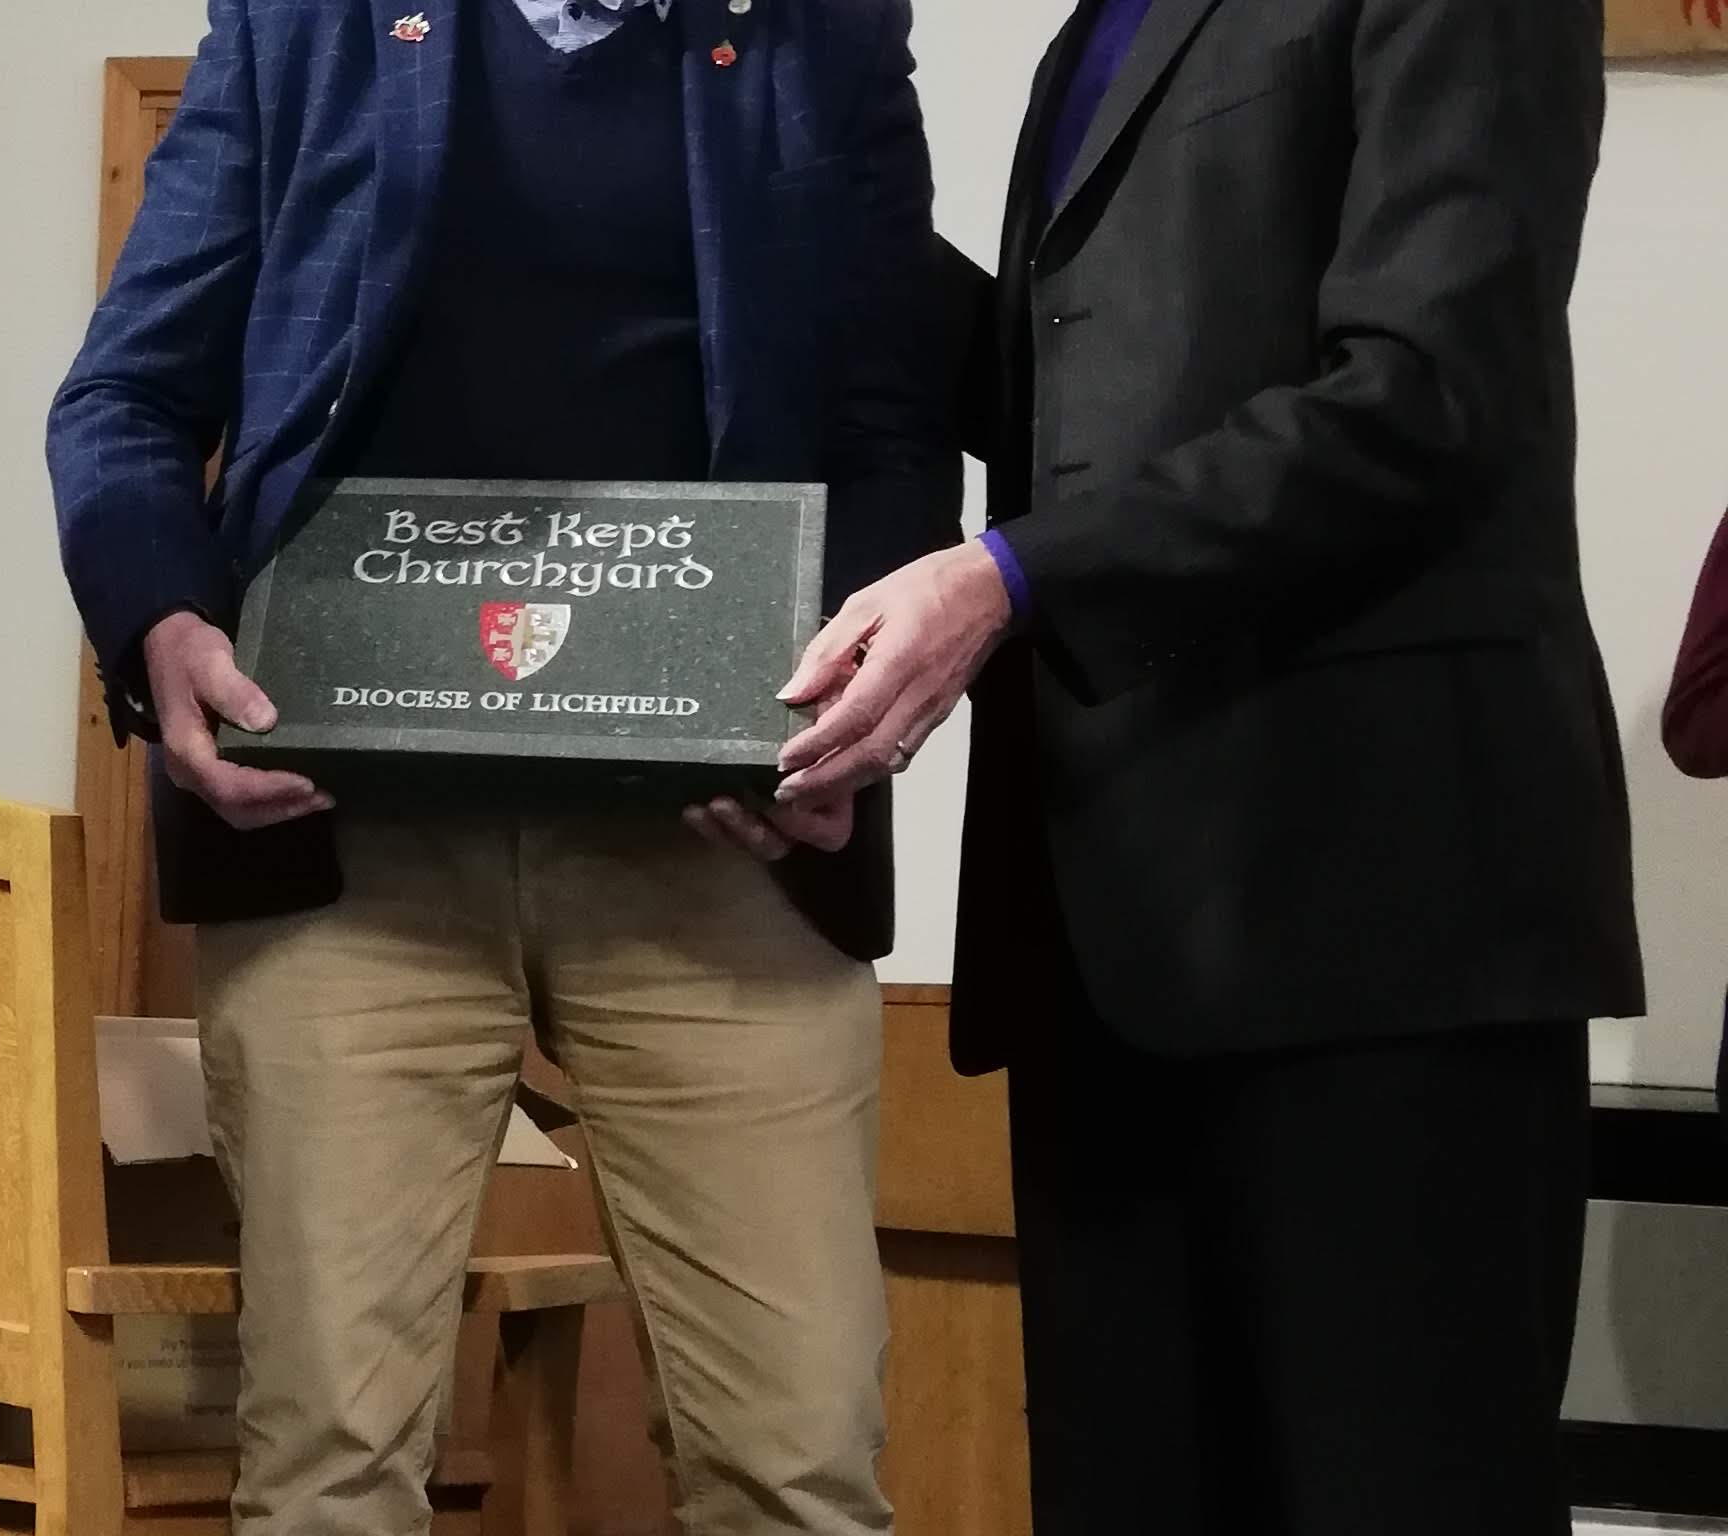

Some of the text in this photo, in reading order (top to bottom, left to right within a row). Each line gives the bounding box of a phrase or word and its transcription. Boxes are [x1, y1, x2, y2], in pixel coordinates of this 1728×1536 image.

[383, 509, 697, 558] Best Kept
[352, 551, 714, 597] Churchyard
[333, 685, 700, 716] DIOCESE OF LICHFIELD
